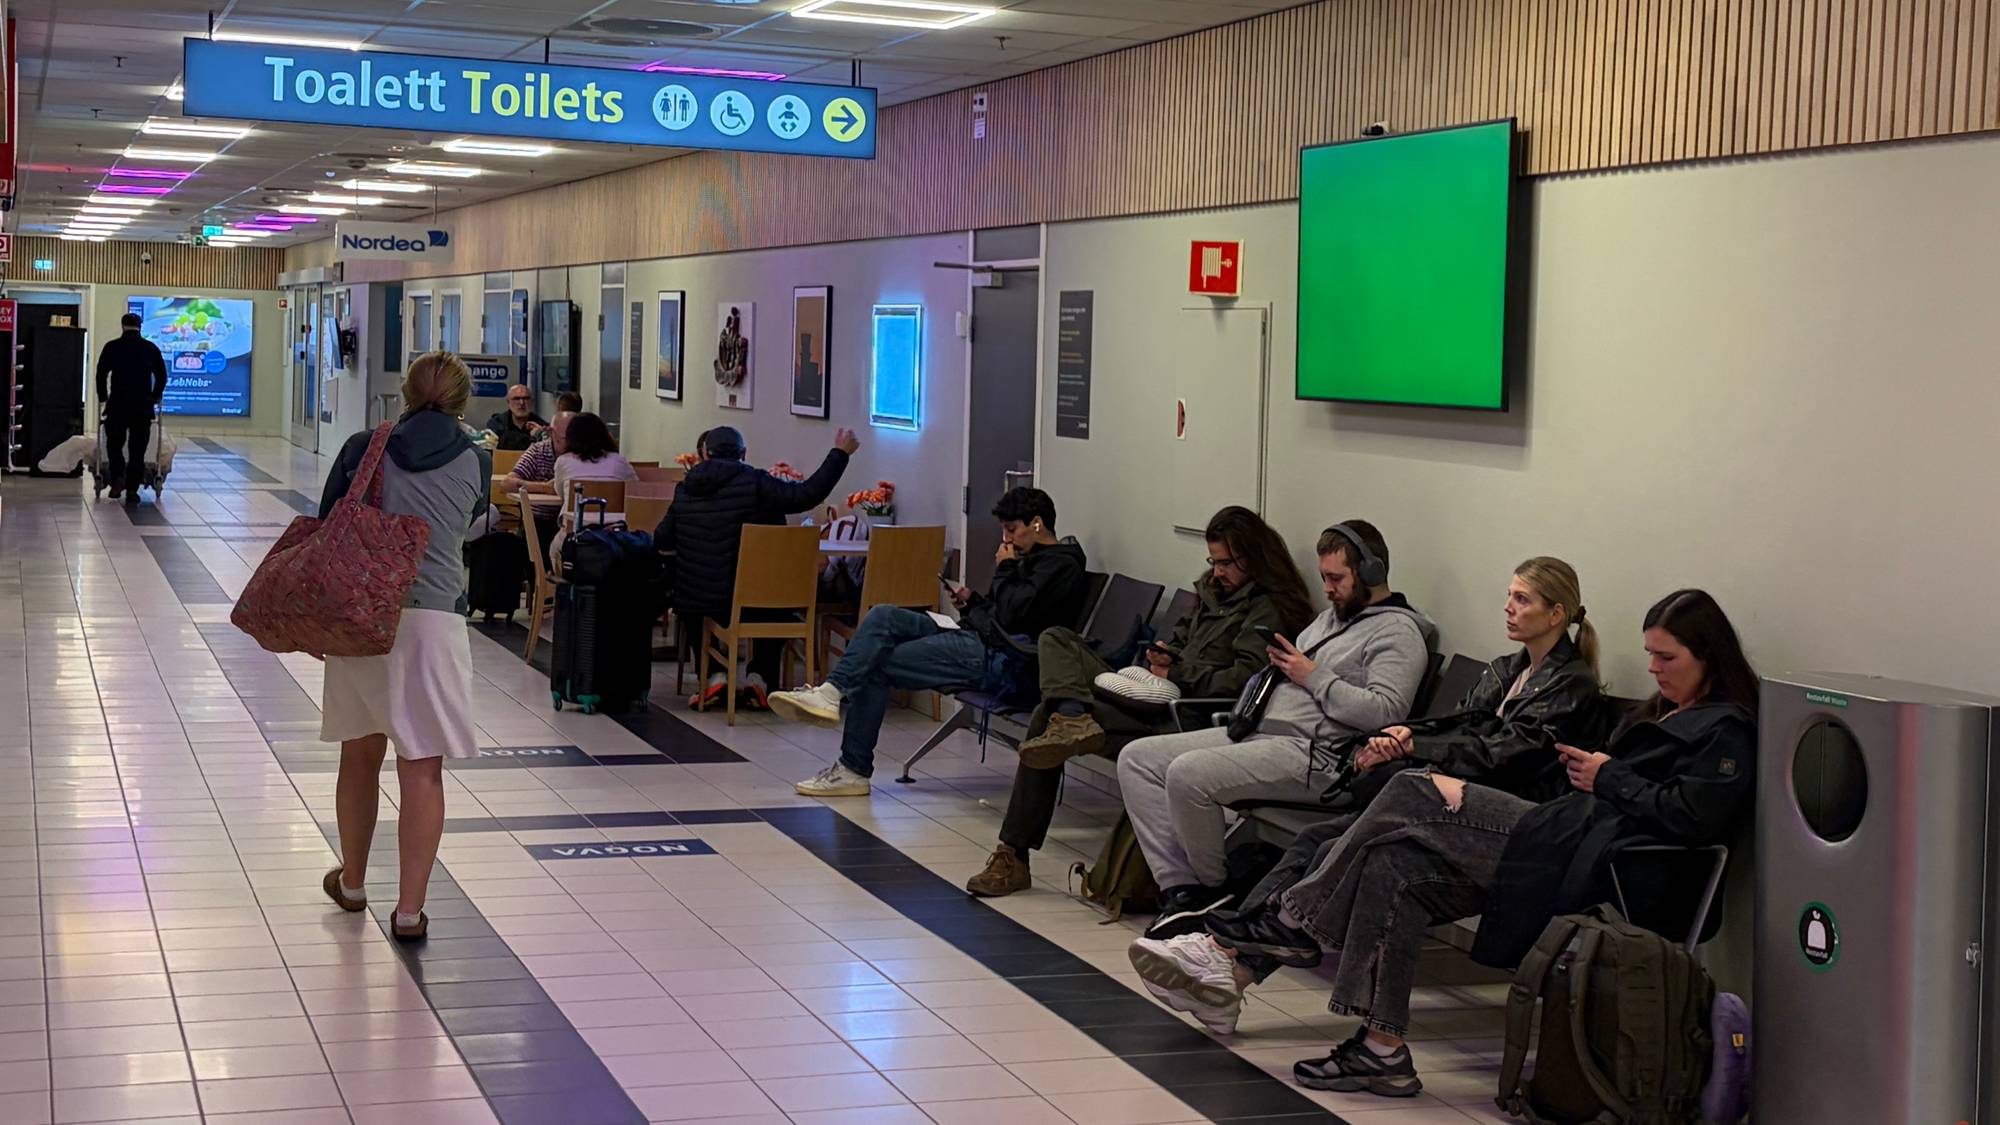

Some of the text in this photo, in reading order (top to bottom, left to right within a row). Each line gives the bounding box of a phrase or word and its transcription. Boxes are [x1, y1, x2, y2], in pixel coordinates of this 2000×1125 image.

[264, 56, 625, 124] Toalett Toilets
[342, 234, 425, 252] Nordea
[470, 366, 506, 379] ange
